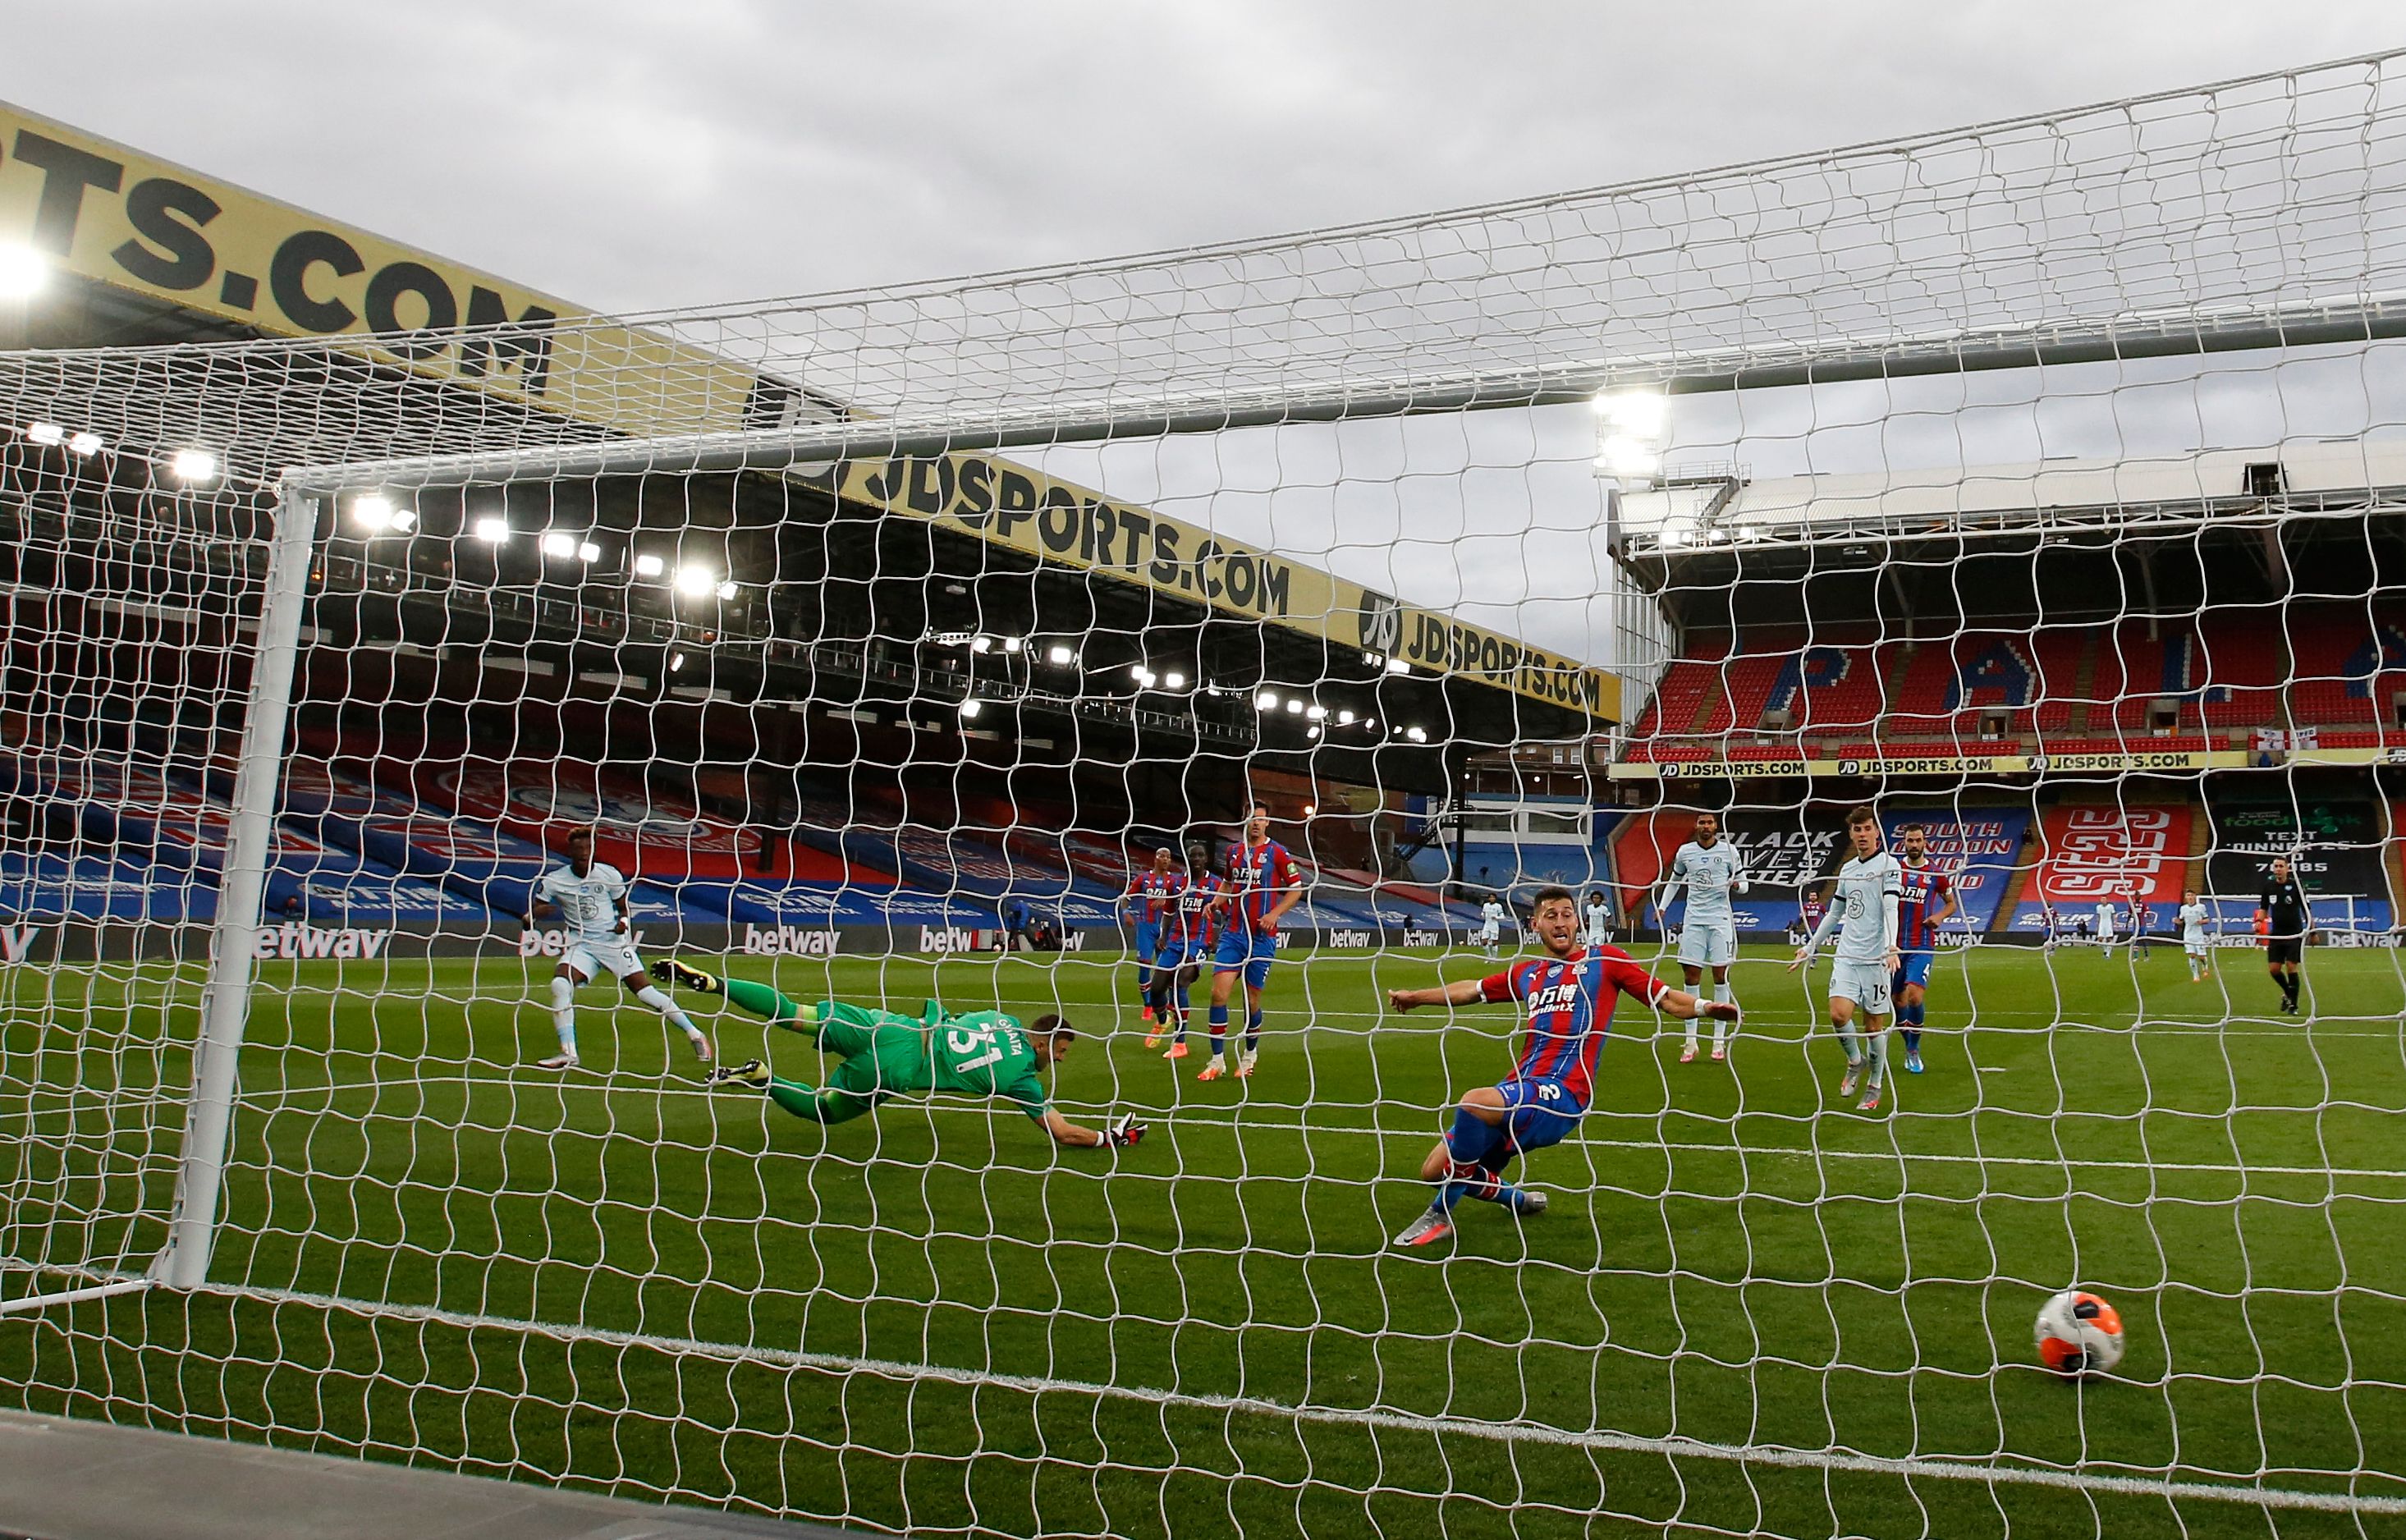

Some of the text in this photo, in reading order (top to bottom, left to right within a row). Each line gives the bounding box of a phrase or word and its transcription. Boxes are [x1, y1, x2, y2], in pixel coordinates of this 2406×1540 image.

[0, 127, 557, 396] TS.COM
[864, 454, 1290, 616] JDSPORTS.COM
[1408, 613, 1600, 712] JDSPORTS.COM
[1661, 763, 1804, 777] JD JDSPORTS.COM
[1841, 759, 1992, 774] JD JDSPORTS.COM
[2054, 754, 2189, 768] JDSPORTS.COM
[1891, 822, 2004, 838] SOUTH
[2265, 831, 2317, 841] TEXT
[1889, 839, 2013, 855] ONDON
[1848, 889, 1865, 919] 3
[252, 920, 388, 959] etway
[745, 922, 841, 955] betway
[920, 924, 972, 953] betw
[1330, 928, 1370, 948] betway
[622, 950, 635, 967] 9
[1538, 983, 1579, 1006] 万博
[947, 1023, 1004, 1073] 31
[997, 1018, 1024, 1056] GUAITA
[1538, 1083, 1562, 1101] 2
